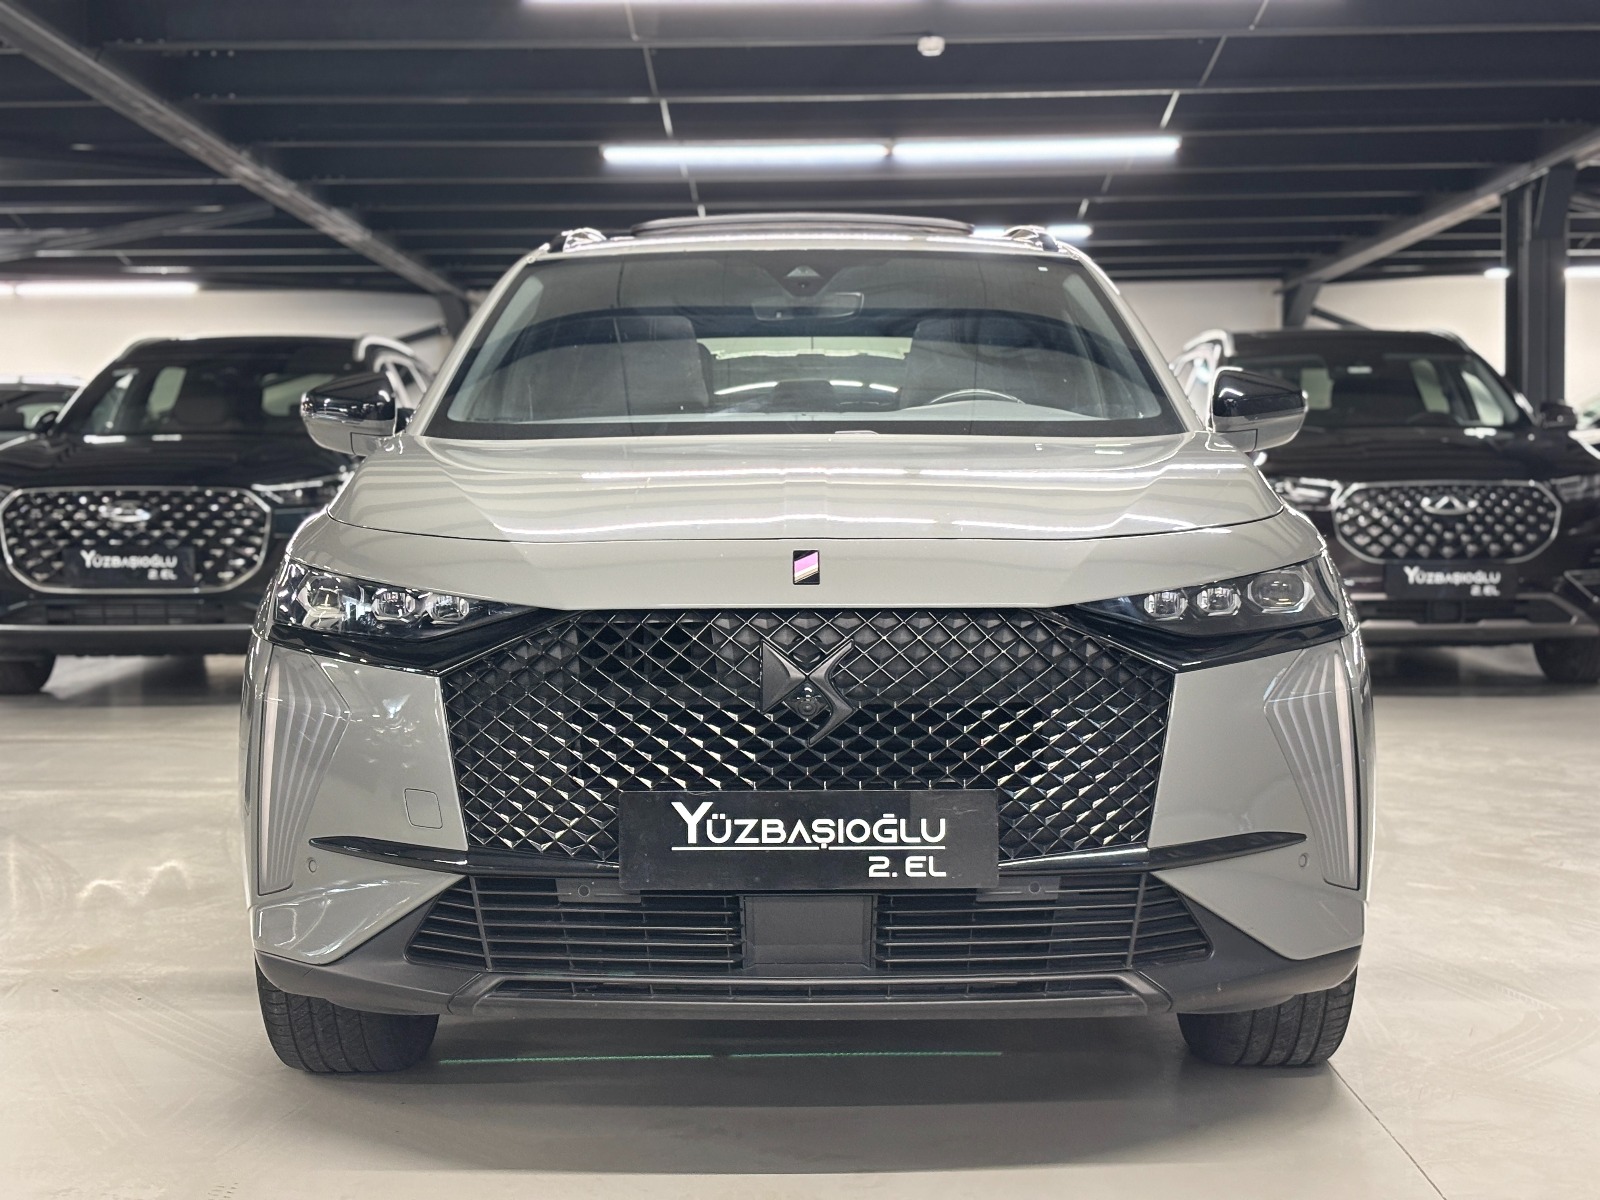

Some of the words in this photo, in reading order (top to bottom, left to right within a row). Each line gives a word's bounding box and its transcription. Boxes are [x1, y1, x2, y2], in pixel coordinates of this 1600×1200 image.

[671, 801, 946, 849] YÜZBAŞIOĞLU
[868, 855, 898, 878] 2.
[904, 855, 947, 878] EL
